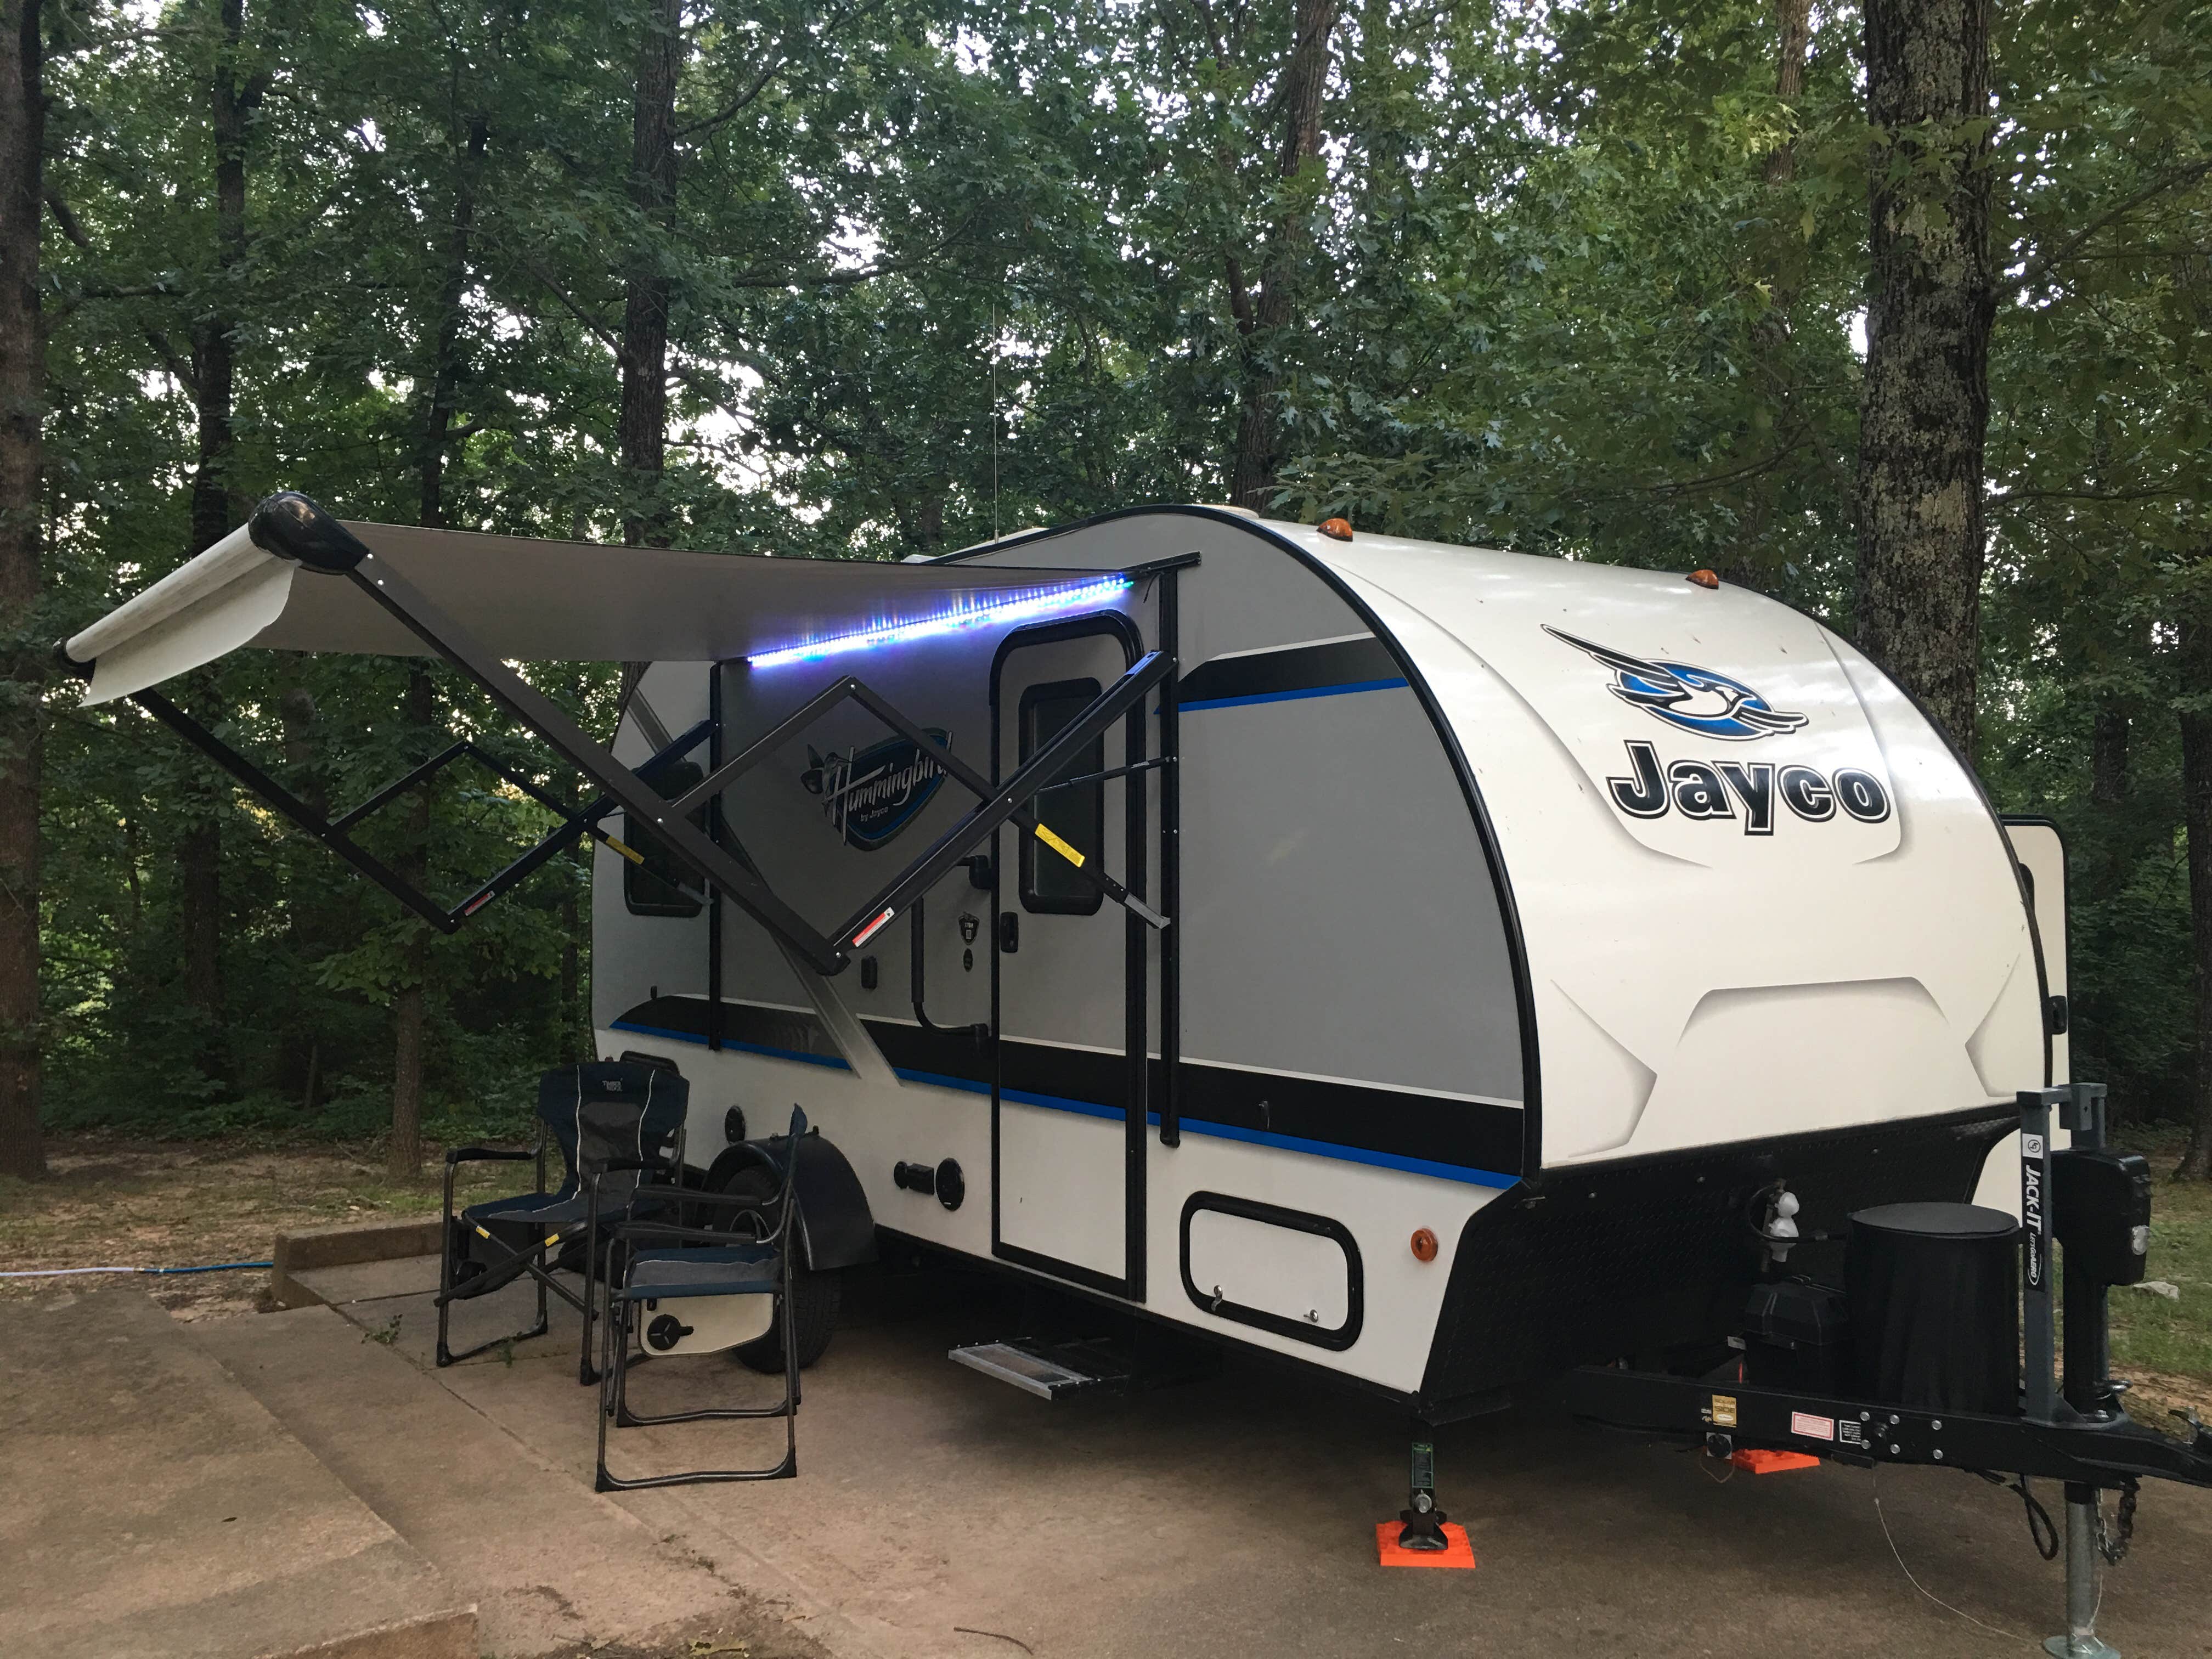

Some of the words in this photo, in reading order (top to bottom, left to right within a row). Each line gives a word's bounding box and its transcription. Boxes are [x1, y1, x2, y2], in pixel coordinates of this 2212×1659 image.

[860, 813, 869, 822] by
[870, 806, 889, 819] Jayco
[1606, 739, 1891, 836] Jayco
